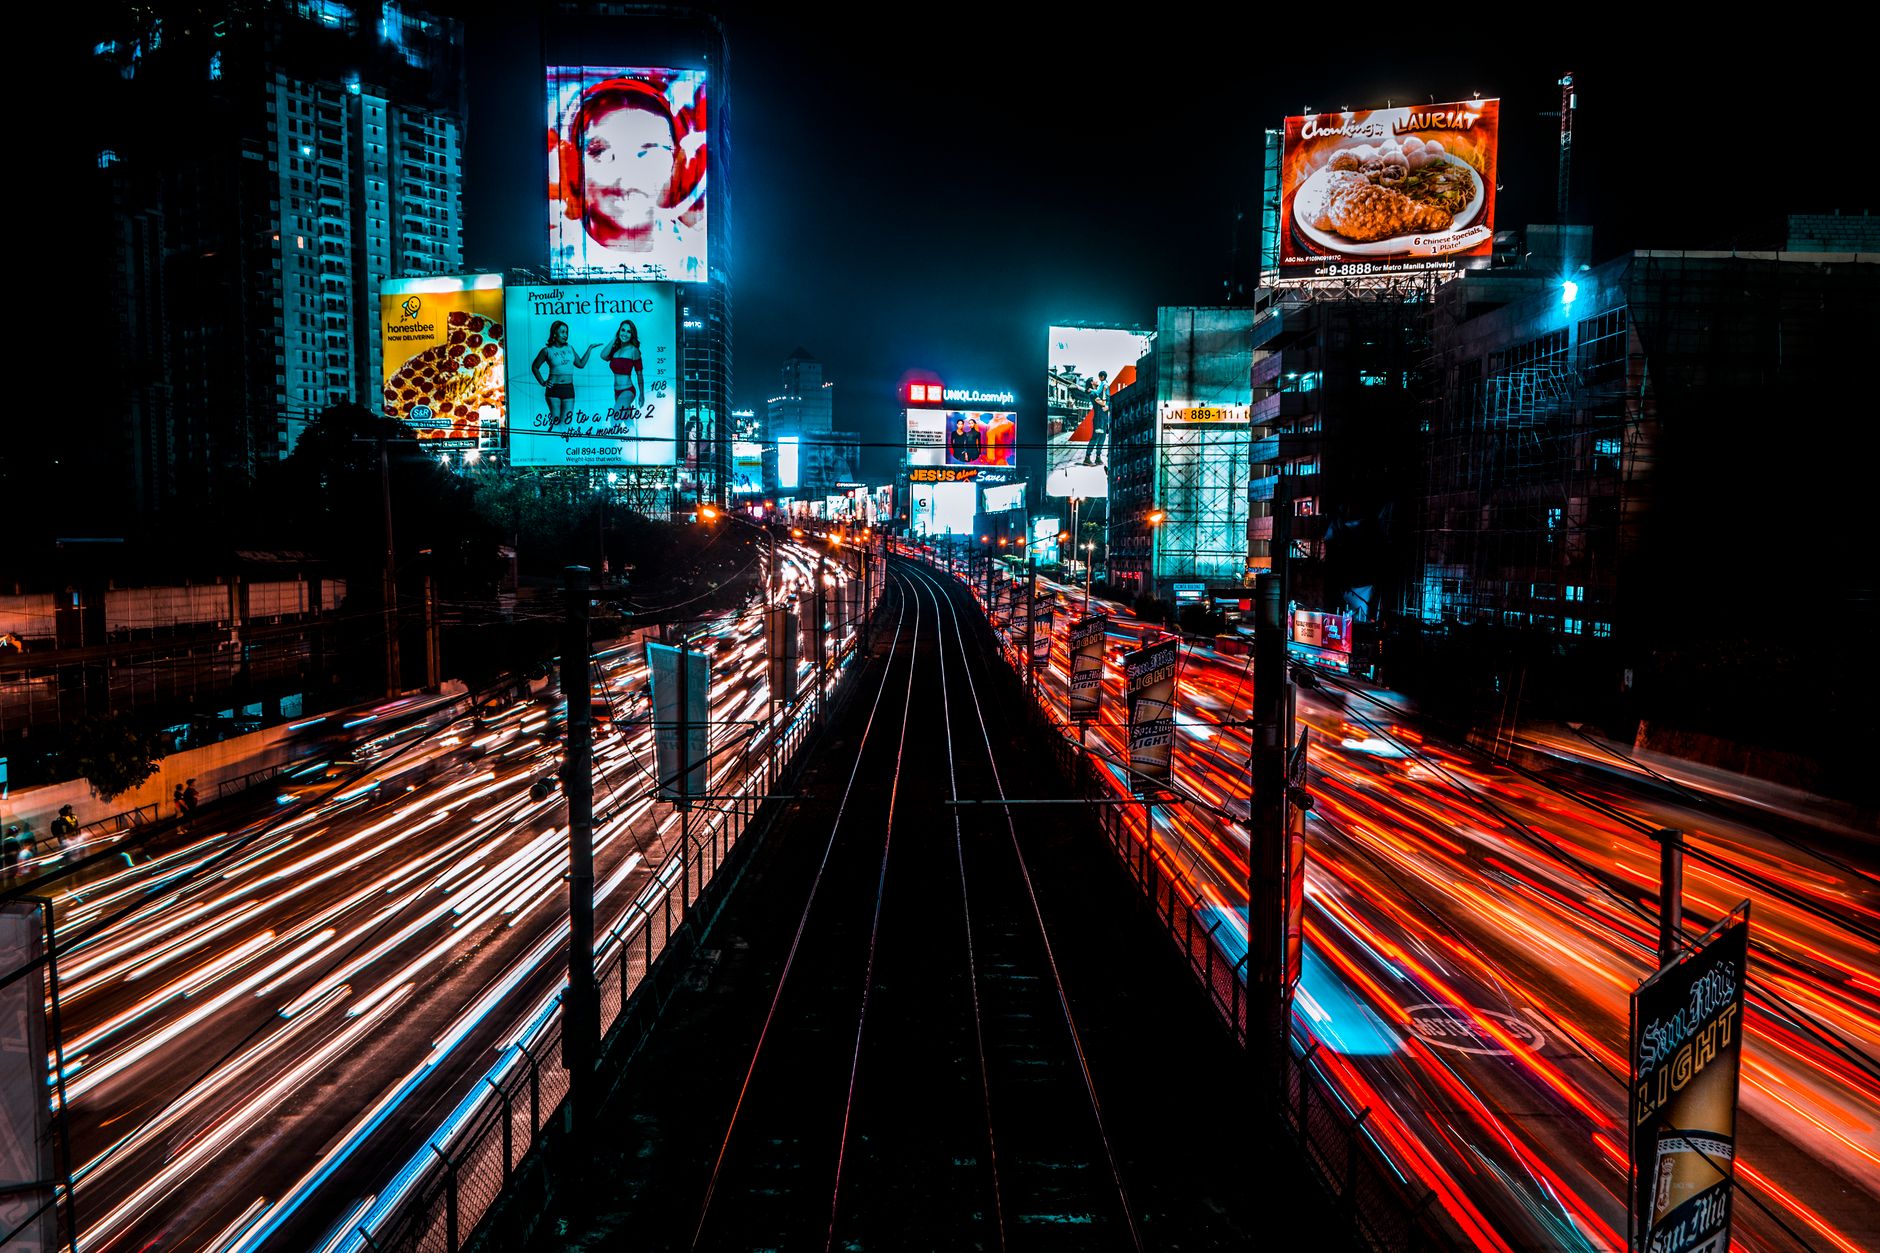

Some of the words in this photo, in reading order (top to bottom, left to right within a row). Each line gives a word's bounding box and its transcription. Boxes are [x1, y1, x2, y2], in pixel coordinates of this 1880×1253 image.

[1392, 111, 1480, 135] LAURIAT
[1414, 237, 1421, 245] 6
[1423, 237, 1451, 245] Chinese
[1329, 263, 1372, 276] 9-8888
[1403, 262, 1424, 270] Manila
[1425, 261, 1456, 269] Delivery!
[528, 289, 564, 301] Proudly
[535, 294, 591, 315] marie
[594, 293, 653, 314] france
[387, 321, 434, 333] honestbee
[651, 380, 667, 391] 108
[943, 389, 1014, 405] UNIQLO.com/ph
[413, 408, 429, 417] S&R
[533, 413, 561, 432] Size
[564, 411, 573, 425] 8
[576, 409, 590, 423] to
[592, 413, 602, 423] a
[606, 407, 642, 421] Petite
[645, 404, 655, 419] 2
[561, 427, 583, 442] after
[585, 427, 593, 437] 4
[596, 424, 629, 435] months
[566, 447, 580, 455] Call
[581, 447, 623, 455] 894-BODY
[910, 469, 955, 481] JESUS
[976, 470, 1006, 482] Saves
[1070, 631, 1105, 652] LIGHT
[1149, 648, 1175, 672] Mig
[1072, 681, 1100, 691] LIGHT
[1127, 664, 1175, 694] LIGHT
[1132, 735, 1168, 750] LIGHT
[1638, 1008, 1687, 1078] San
[1687, 960, 1736, 1037] Mig
[1637, 1002, 1737, 1126] LIGHT
[1687, 1187, 1727, 1246] Mig
